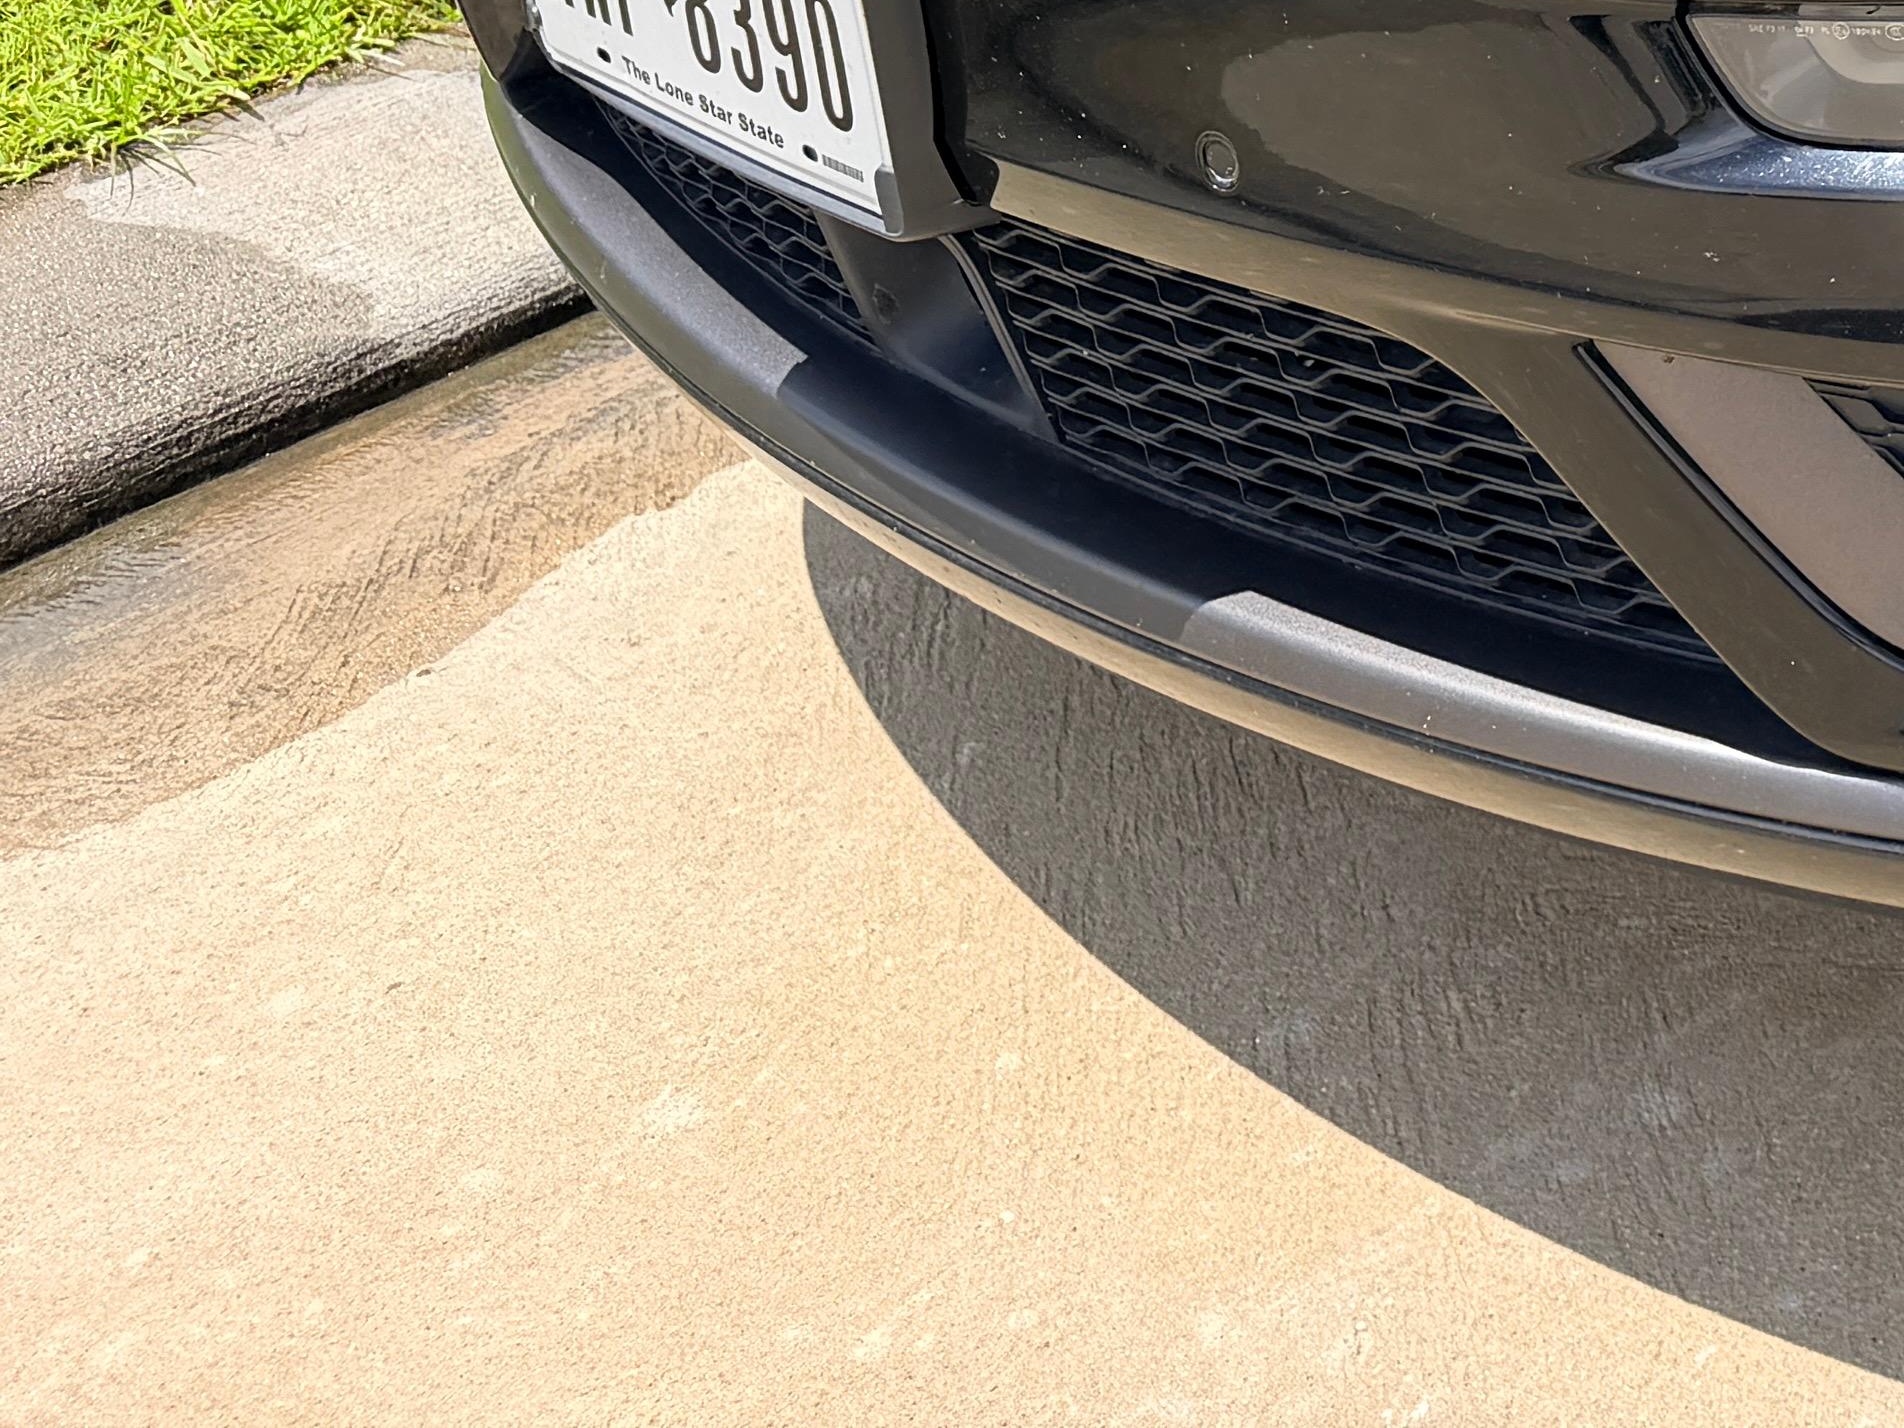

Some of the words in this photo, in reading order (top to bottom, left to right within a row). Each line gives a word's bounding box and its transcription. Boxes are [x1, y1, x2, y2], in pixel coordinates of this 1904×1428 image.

[621, 55, 653, 85] The
[655, 70, 695, 107] Lone
[698, 93, 735, 126] Star
[738, 112, 786, 150] State
